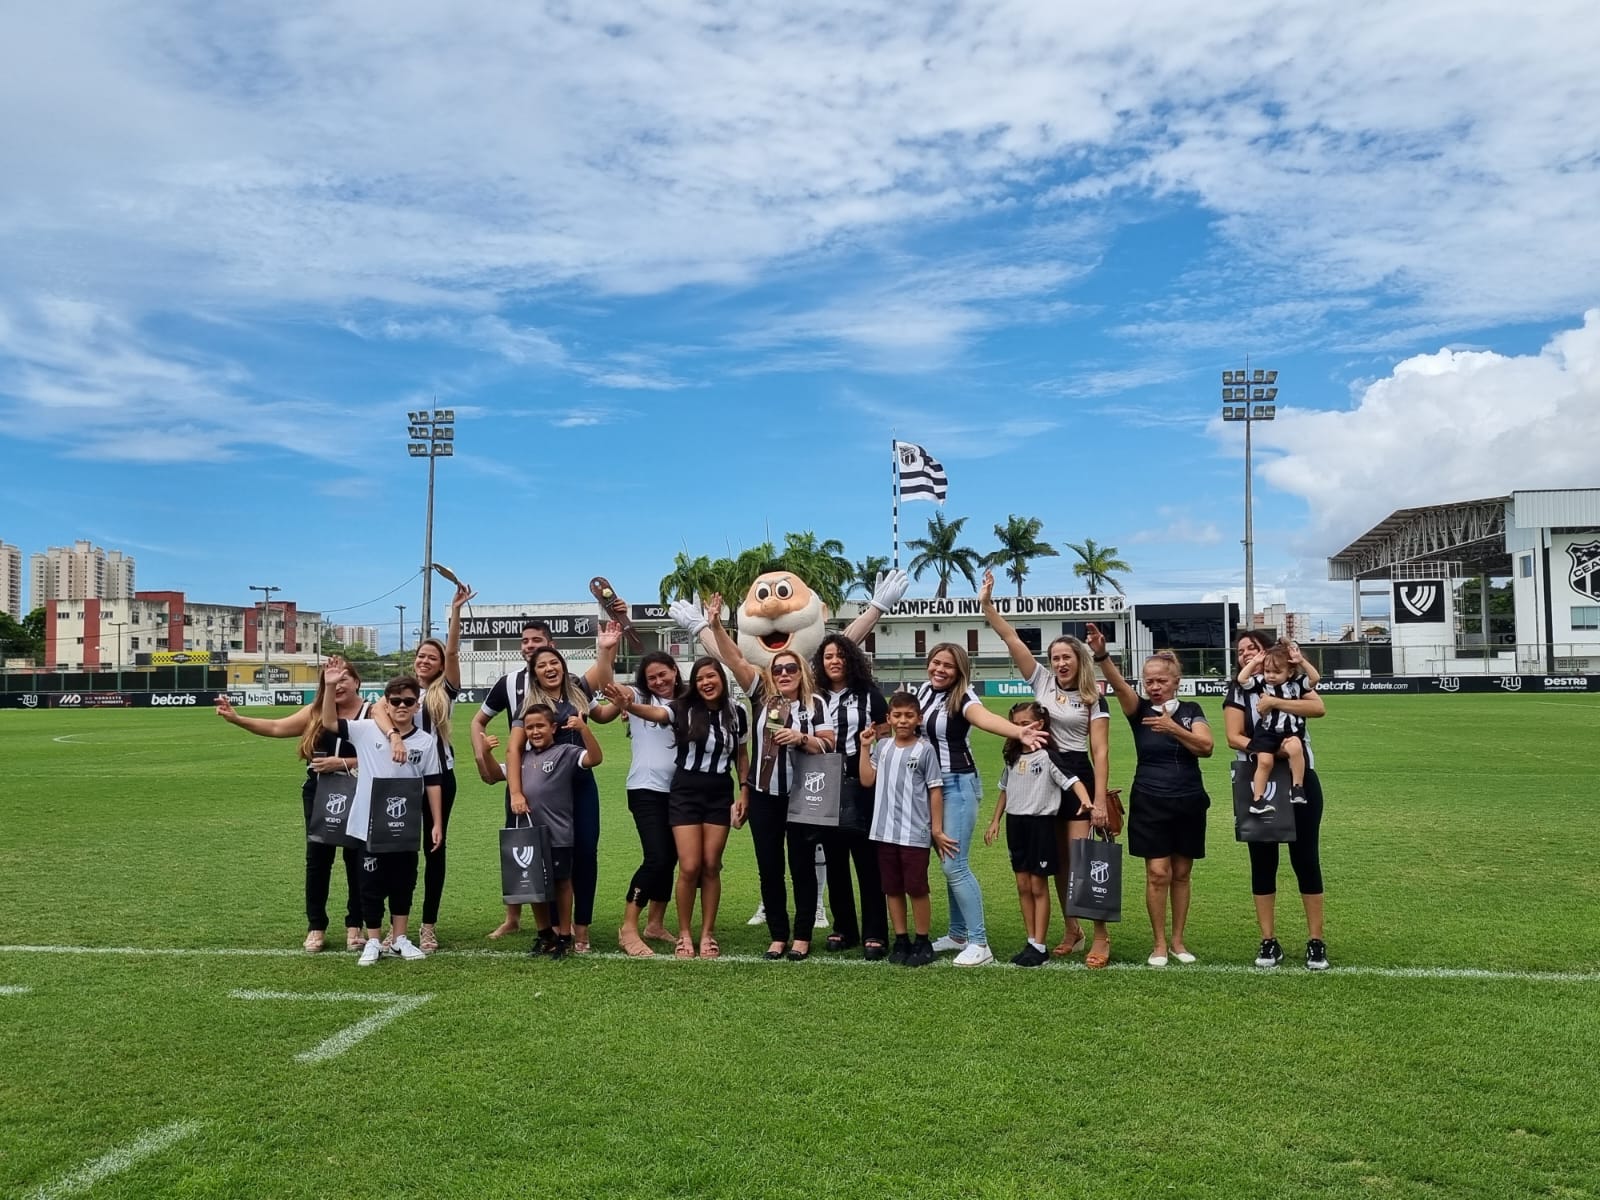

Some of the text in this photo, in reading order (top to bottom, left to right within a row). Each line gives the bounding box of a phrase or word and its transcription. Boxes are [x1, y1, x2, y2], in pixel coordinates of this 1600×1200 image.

[887, 597, 1104, 615] CAMPEÃO INVTO DO NORDESTE
[492, 620, 530, 634] SPORT
[1315, 681, 1355, 690] betcris
[151, 693, 197, 705] betcris
[254, 693, 273, 705] bmg
[282, 693, 302, 705] bmg
